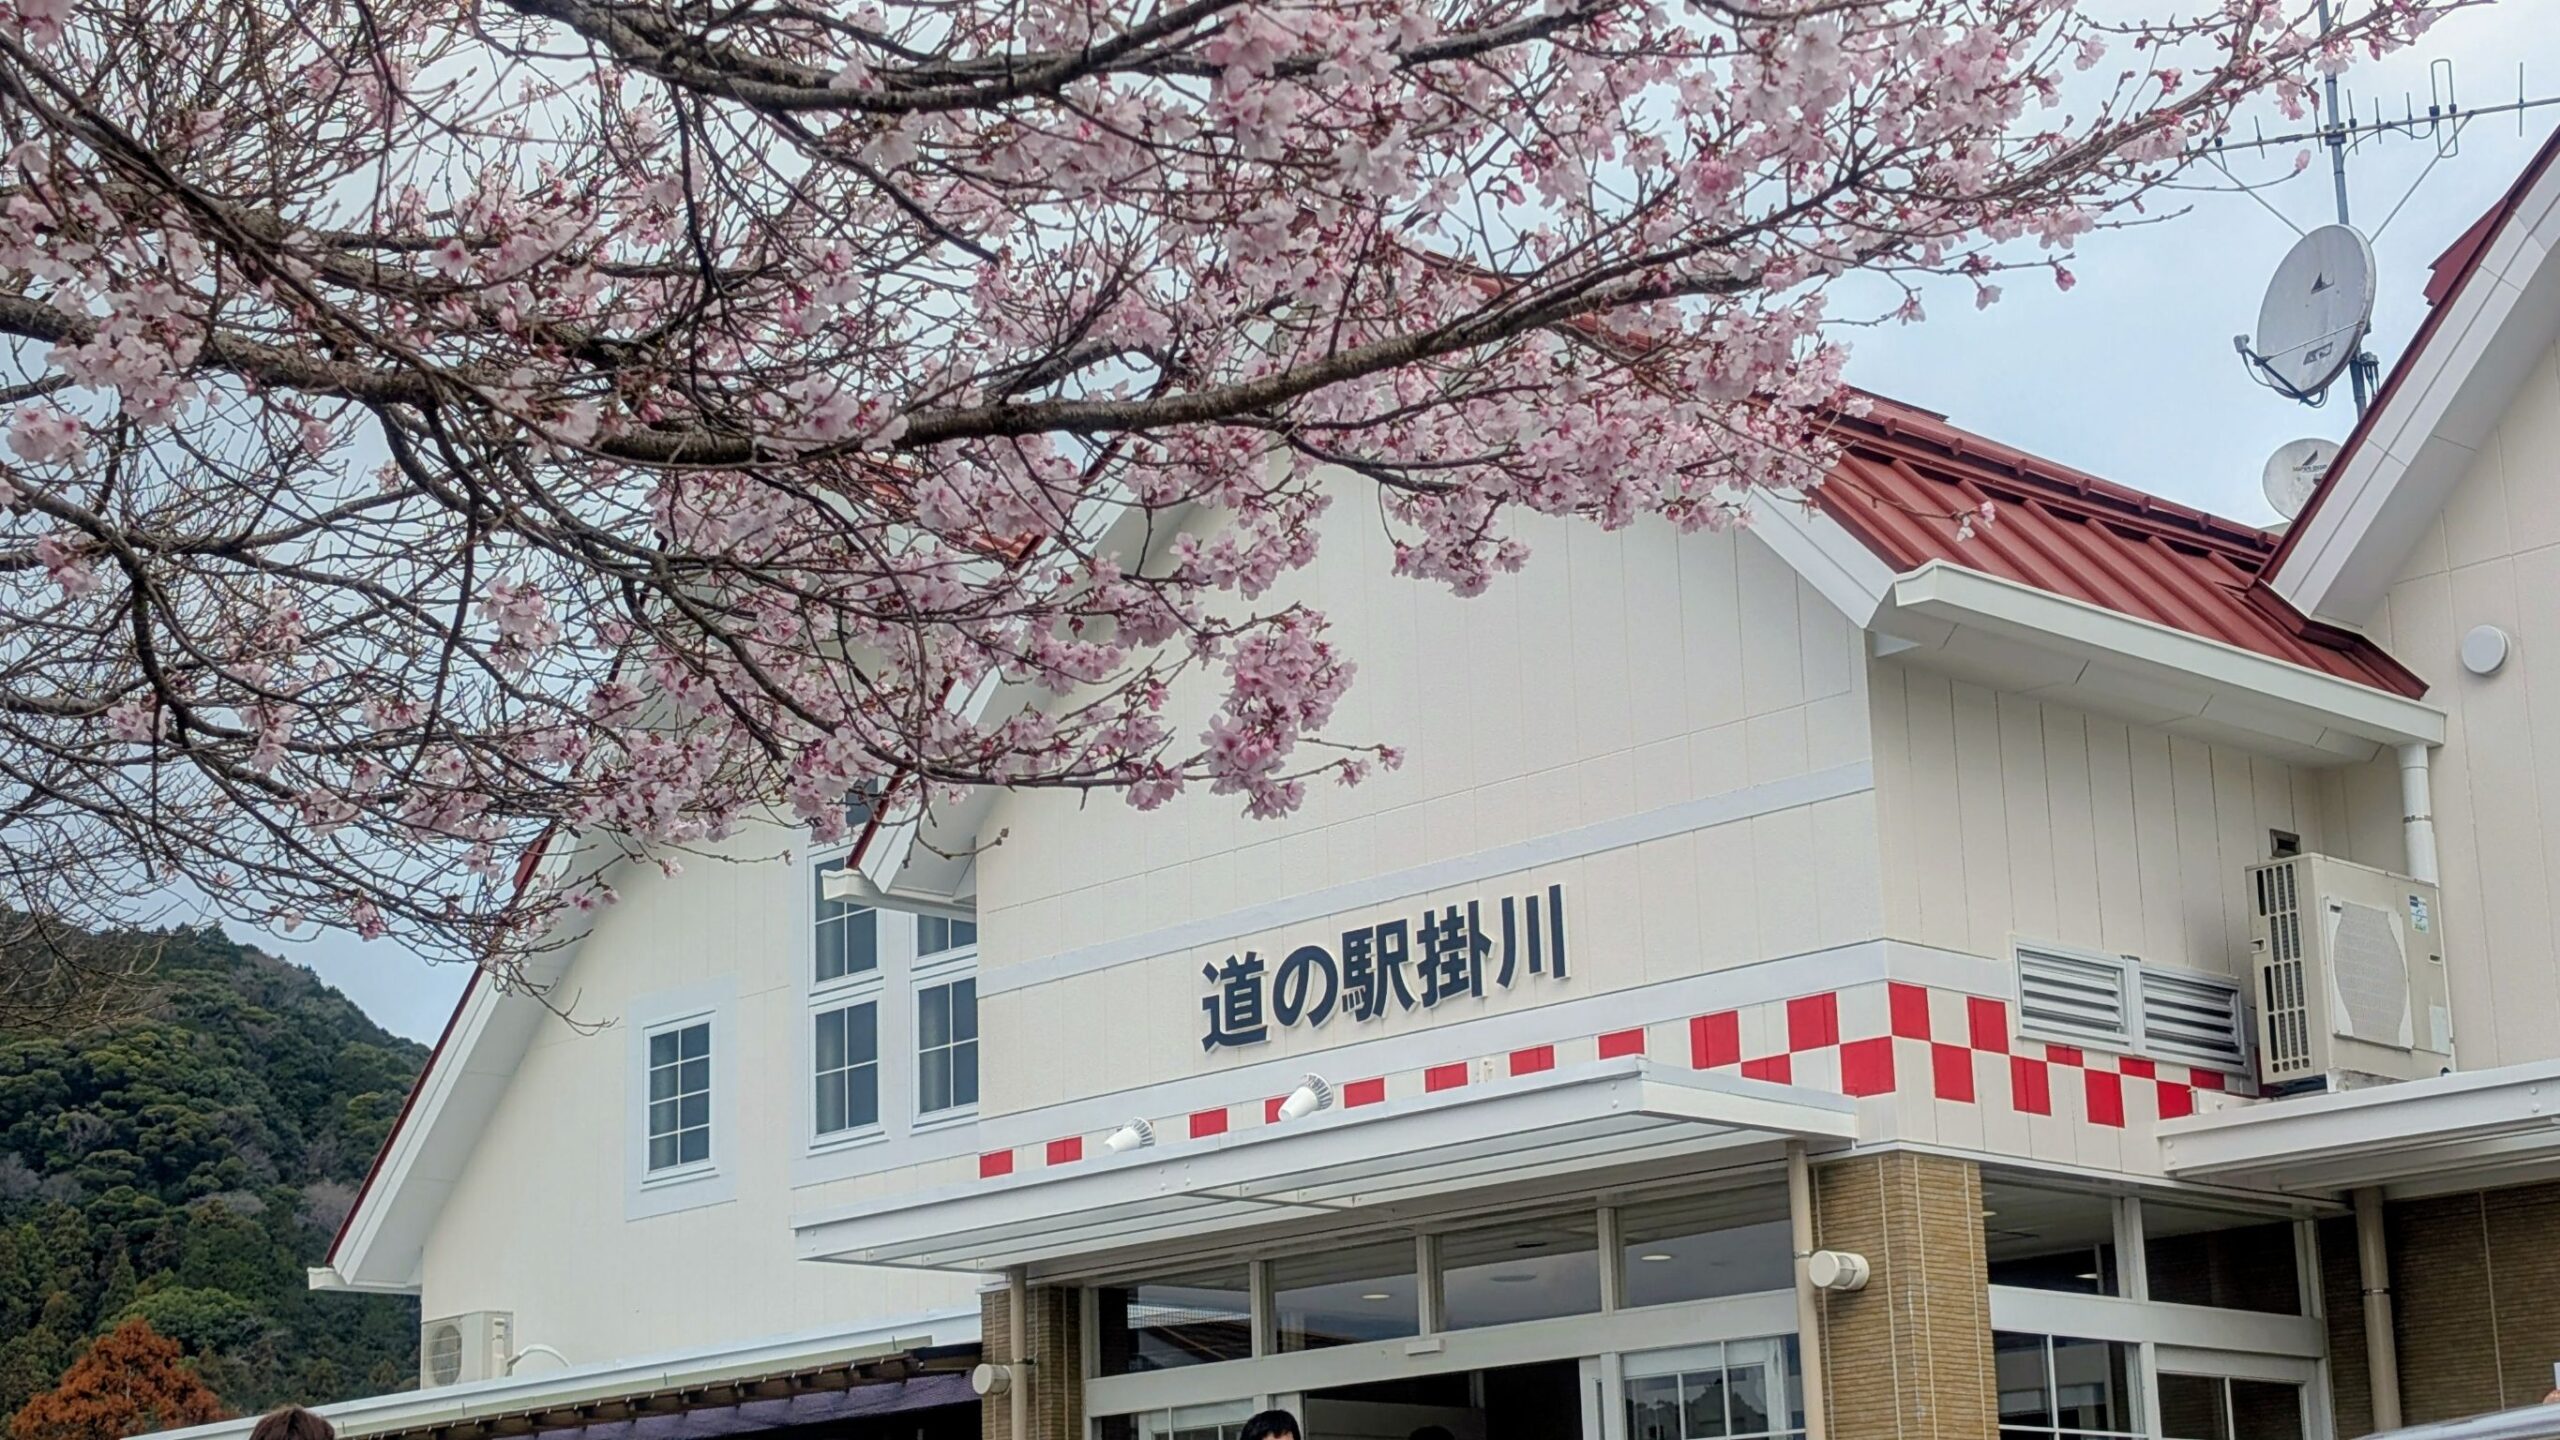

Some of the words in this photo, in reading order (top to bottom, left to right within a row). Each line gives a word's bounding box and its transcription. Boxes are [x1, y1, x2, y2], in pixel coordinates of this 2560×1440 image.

[1201, 884, 1568, 1052] 道の駅掛川
